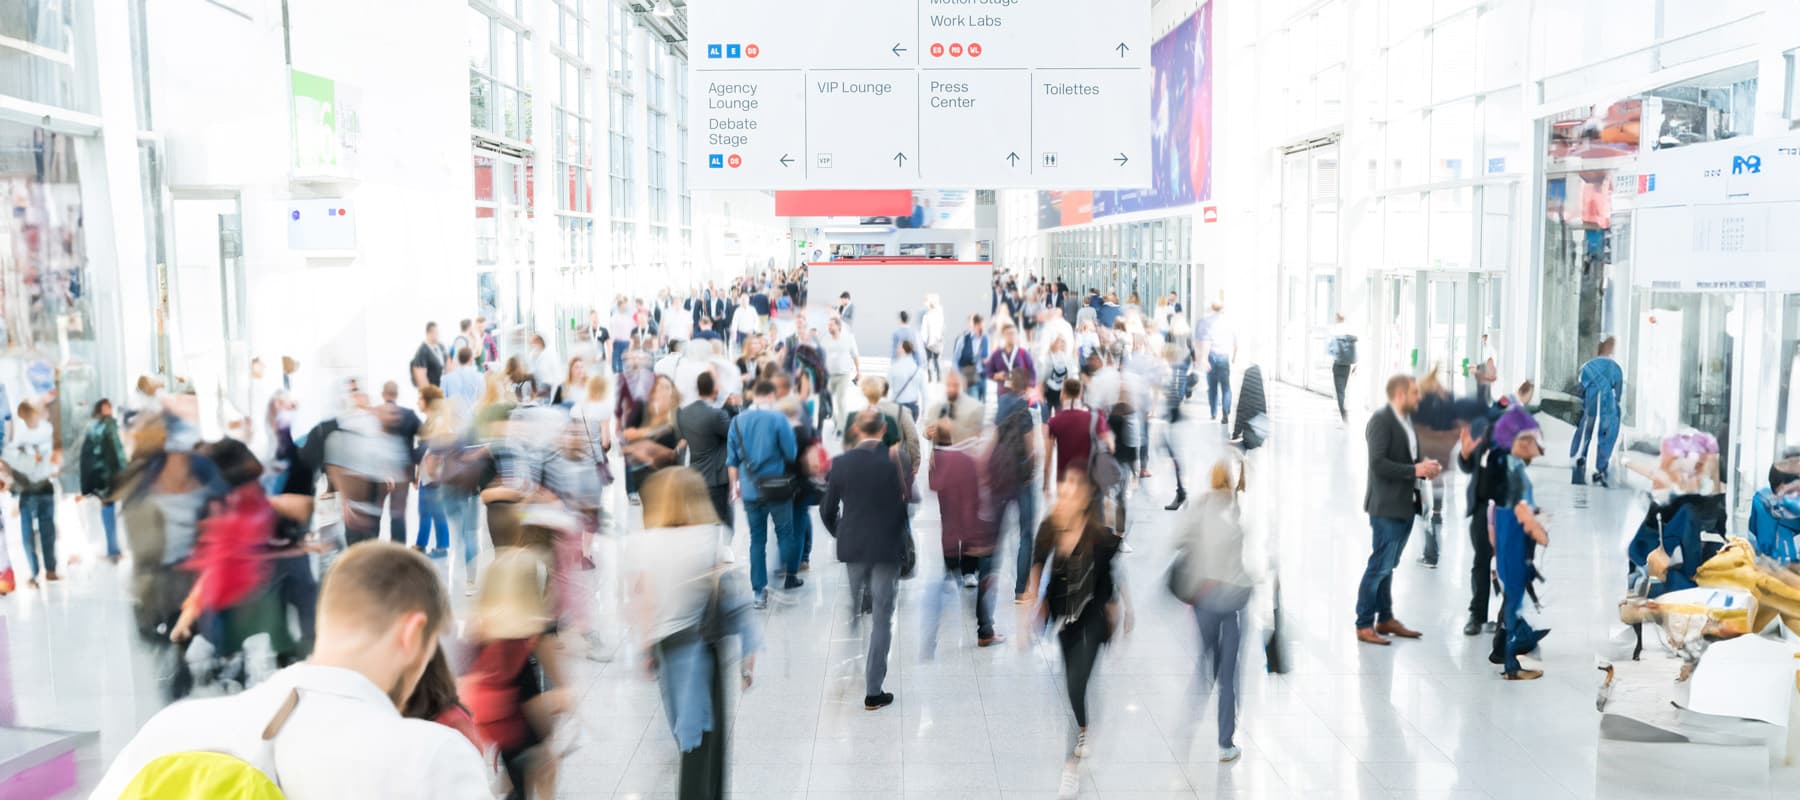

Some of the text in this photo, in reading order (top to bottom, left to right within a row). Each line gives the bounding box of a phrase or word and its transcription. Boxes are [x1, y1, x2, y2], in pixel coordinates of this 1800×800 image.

[930, 15, 1002, 27] Work Labs
[708, 82, 758, 97] Agency
[817, 81, 892, 96] VIP Lounge
[930, 81, 969, 93] Press
[1044, 83, 1100, 96] Toilettes
[708, 97, 759, 112] Lounge
[930, 96, 976, 109] Center
[709, 117, 758, 130] Debate
[708, 133, 748, 148] Stage
